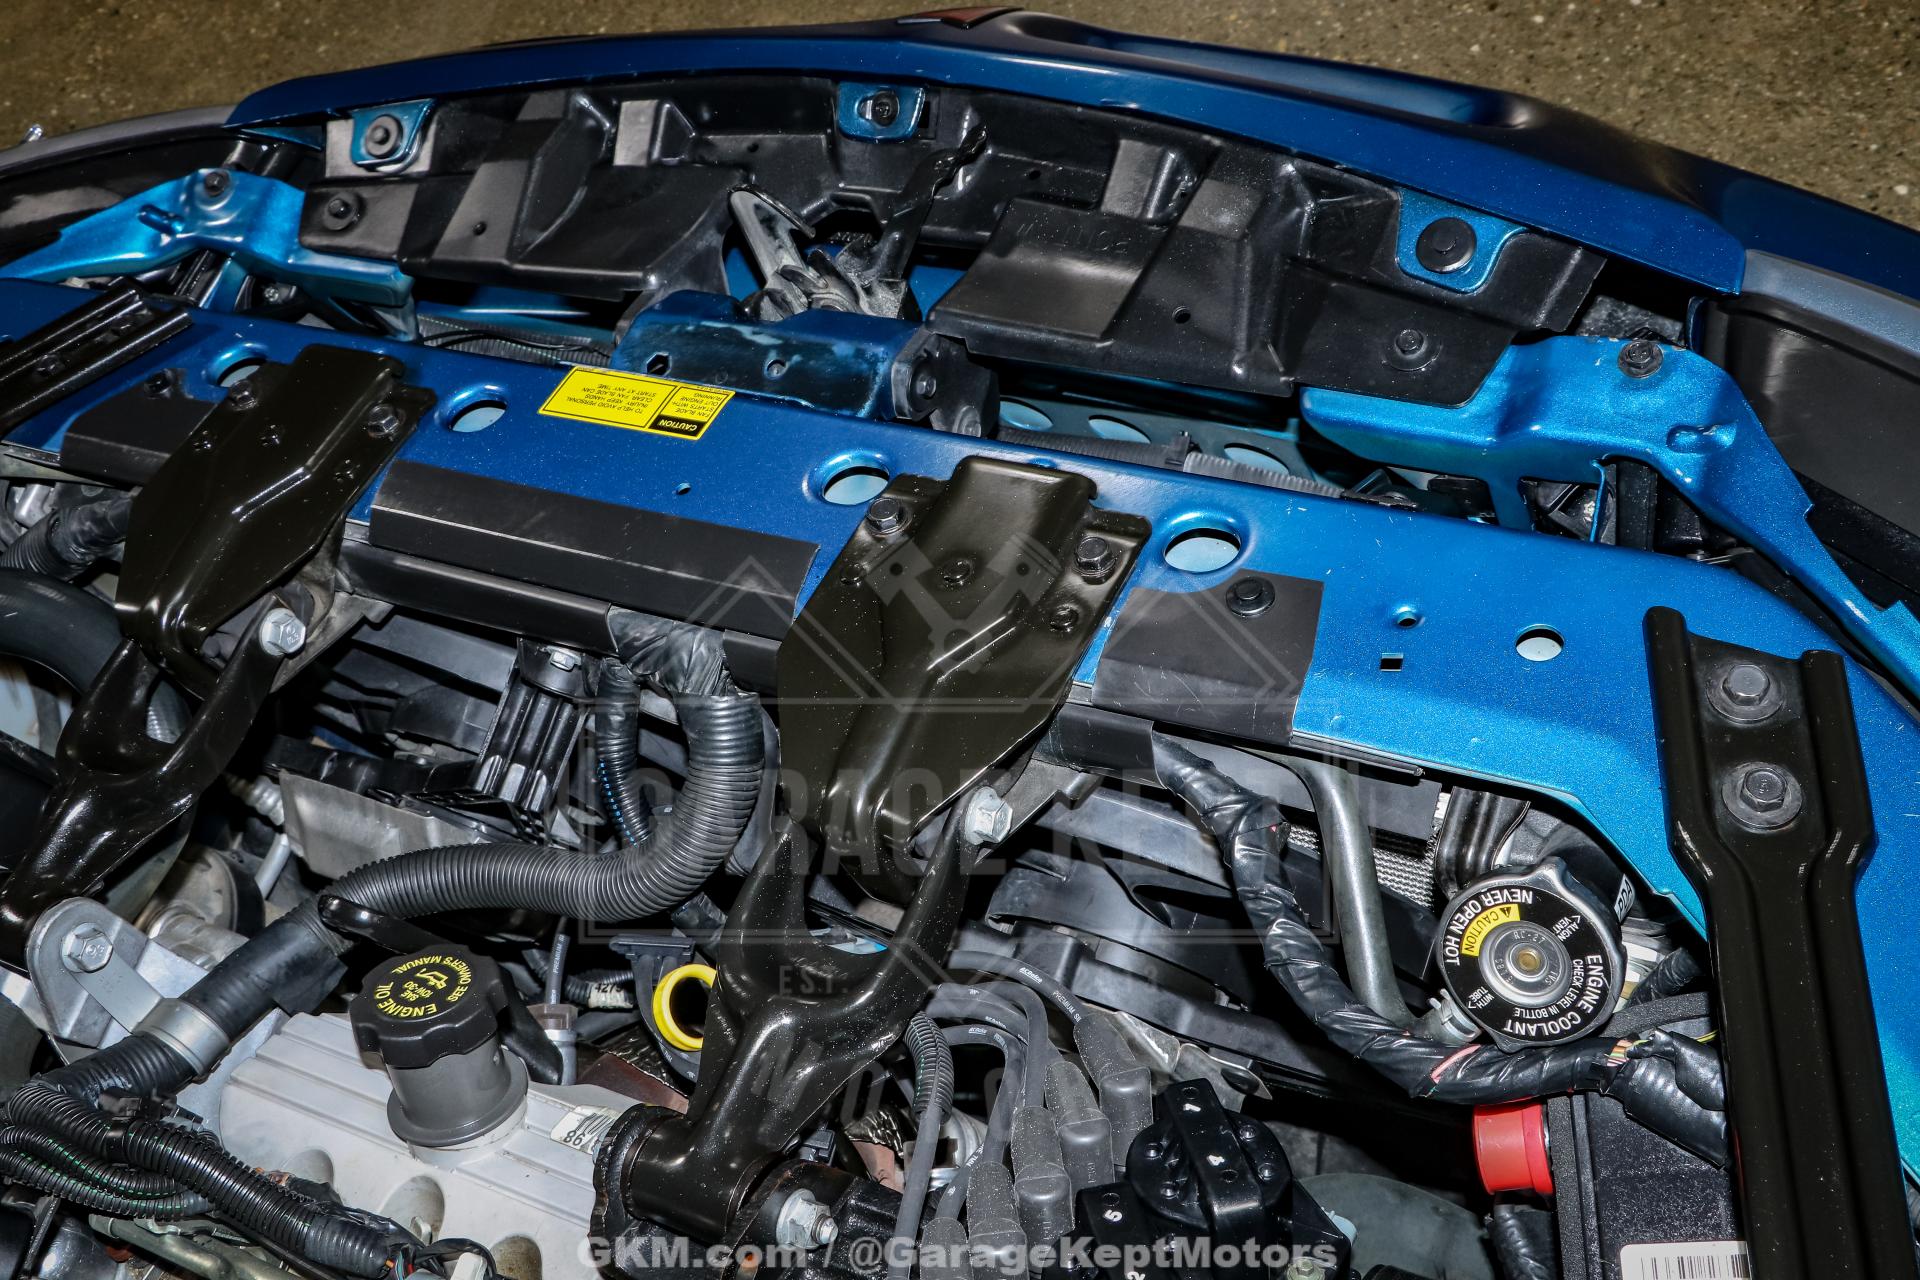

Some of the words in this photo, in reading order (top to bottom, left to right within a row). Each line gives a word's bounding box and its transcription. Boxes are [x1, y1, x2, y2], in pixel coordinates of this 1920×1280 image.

[565, 397, 597, 407] PERSONAL
[584, 394, 606, 402] HANDS
[596, 389, 615, 397] BLADE
[637, 390, 657, 398] START
[693, 392, 723, 401] RUNNING
[598, 402, 617, 410] AVOID
[617, 405, 634, 413] HELP
[675, 408, 696, 416] BLADE
[690, 404, 715, 412] STARTS
[658, 419, 698, 432] CAUTION
[1480, 889, 1534, 905] NEVER
[1455, 899, 1482, 932] OPEN
[1463, 909, 1500, 953] CAUTION
[1552, 916, 1574, 936] VENT
[1557, 924, 1580, 943] ALIGN
[1444, 933, 1461, 966] HOT
[391, 955, 442, 975] MANUAL
[443, 956, 472, 985] OWNER'S
[1571, 958, 1584, 987] CHECK
[374, 981, 394, 1000] OIL
[403, 981, 434, 998] 10W-30
[1581, 954, 1604, 1014] ENGINE
[400, 989, 420, 1002] SAE
[446, 985, 469, 1003] SEE
[1053, 991, 1076, 1014] PREMIUM
[1469, 985, 1489, 1002] TUBE
[1478, 991, 1495, 1011] WITH
[1560, 987, 1579, 1009] LEVEL
[376, 998, 438, 1018] ENGINE
[1514, 1006, 1549, 1019] BOTTLE
[1503, 1011, 1582, 1037] COOLANT
